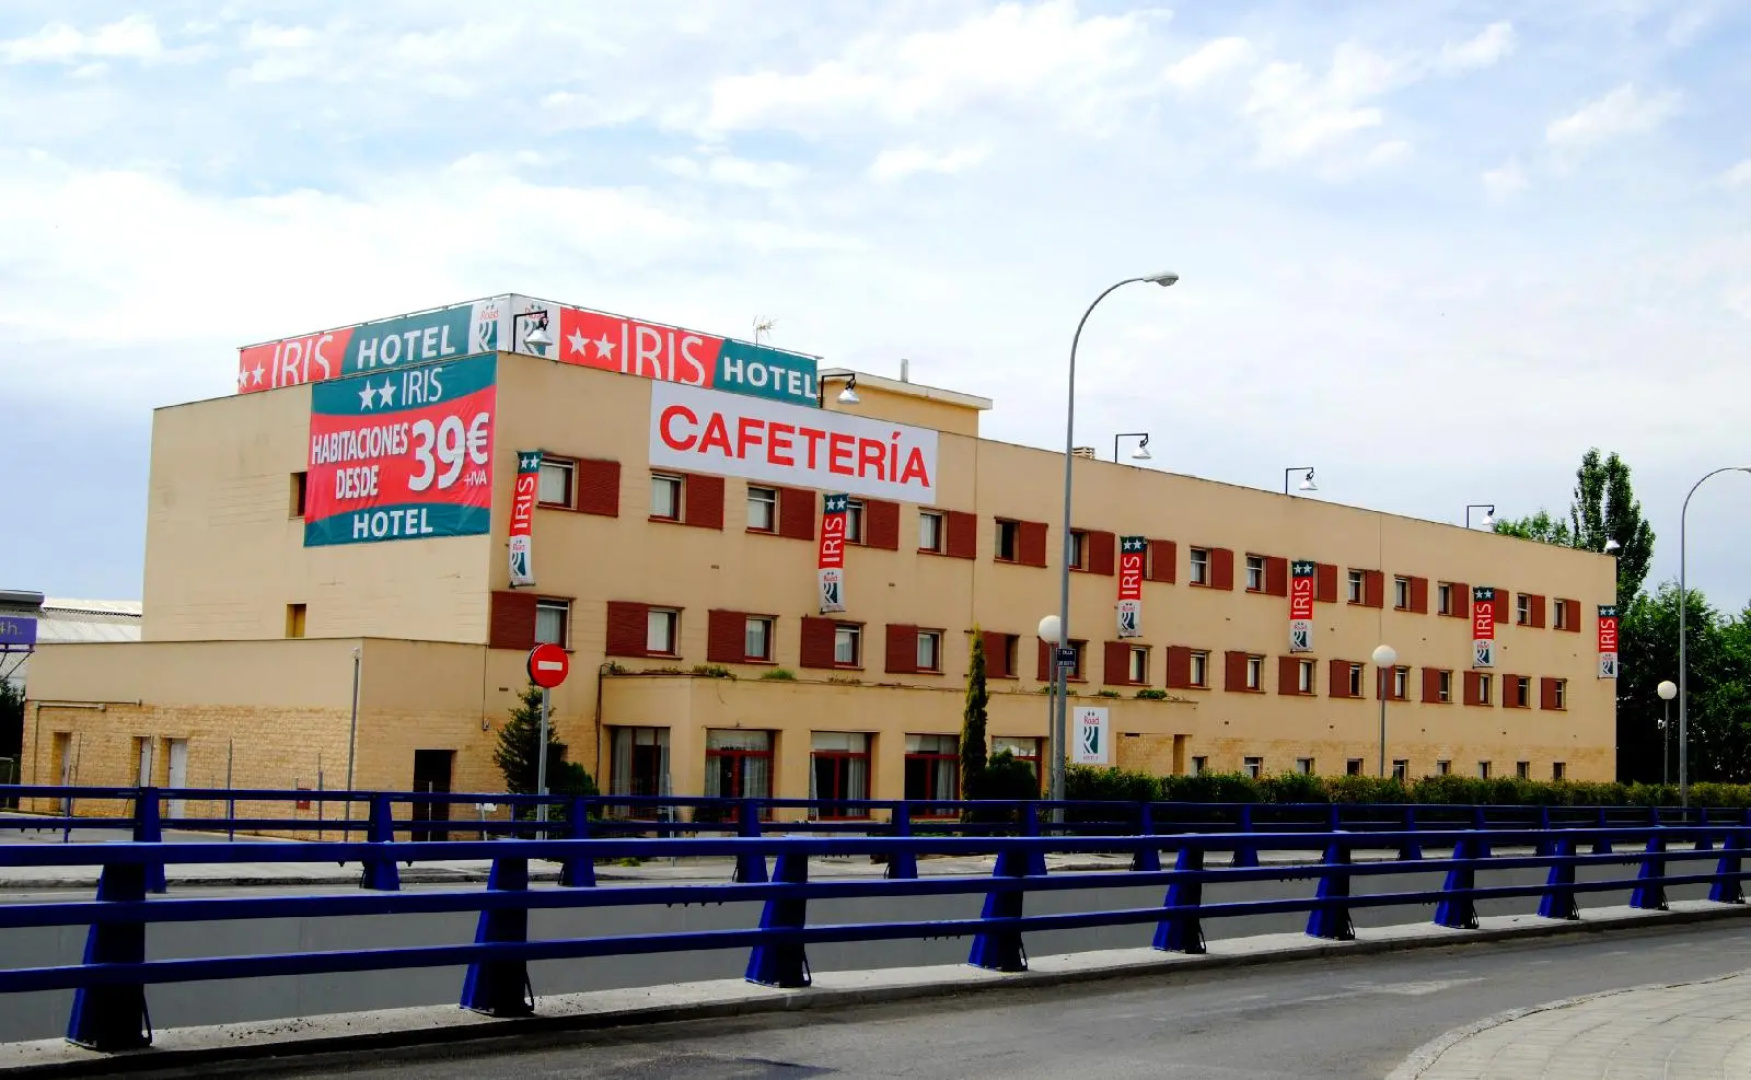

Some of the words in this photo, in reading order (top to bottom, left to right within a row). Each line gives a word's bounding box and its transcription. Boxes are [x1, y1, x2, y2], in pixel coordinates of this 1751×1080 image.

[271, 335, 333, 388] IRIS
[357, 325, 456, 369] HOTEL
[621, 323, 706, 385] IRIS
[724, 357, 817, 399] HOTEL
[401, 367, 443, 406] IRIS
[312, 422, 409, 465] HABITACIONES
[660, 405, 930, 487] CAFETERÍA
[335, 465, 379, 499] DESDE
[514, 476, 534, 528] IRIS
[353, 508, 433, 539] HOTEL
[823, 517, 843, 562] IRIS
[1122, 556, 1140, 595] IRIS
[1293, 579, 1310, 615] IRIS
[1476, 603, 1491, 635] IRIS
[1601, 619, 1615, 649] IRIS
